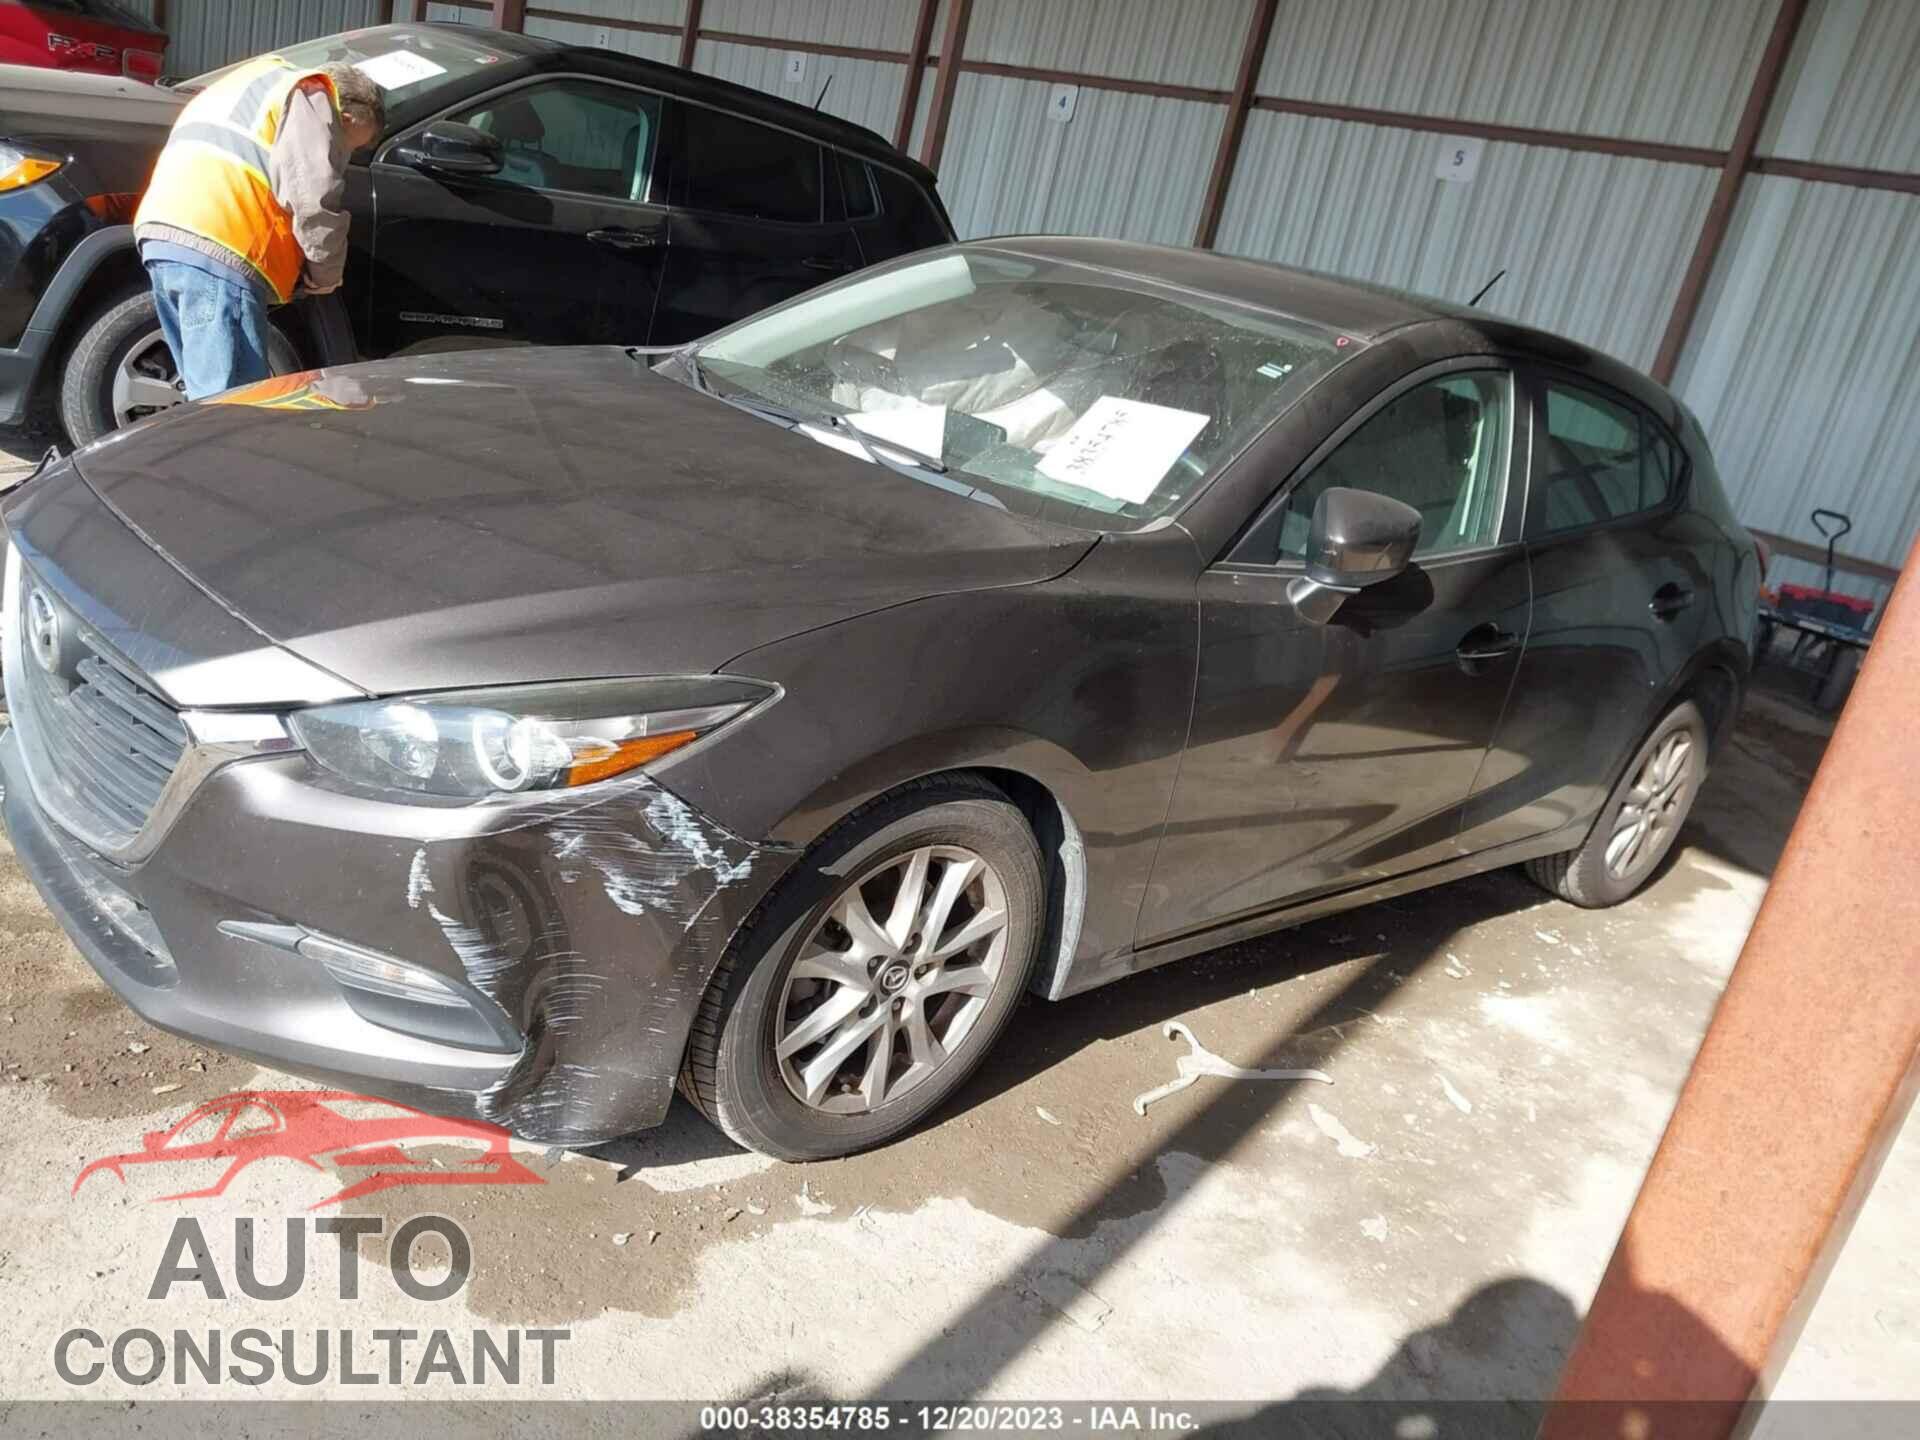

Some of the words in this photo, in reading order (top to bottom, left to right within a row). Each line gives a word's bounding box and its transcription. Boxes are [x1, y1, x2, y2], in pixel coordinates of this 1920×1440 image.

[793, 60, 800, 72] 3
[1058, 95, 1068, 110] 4
[1452, 149, 1465, 167] 5
